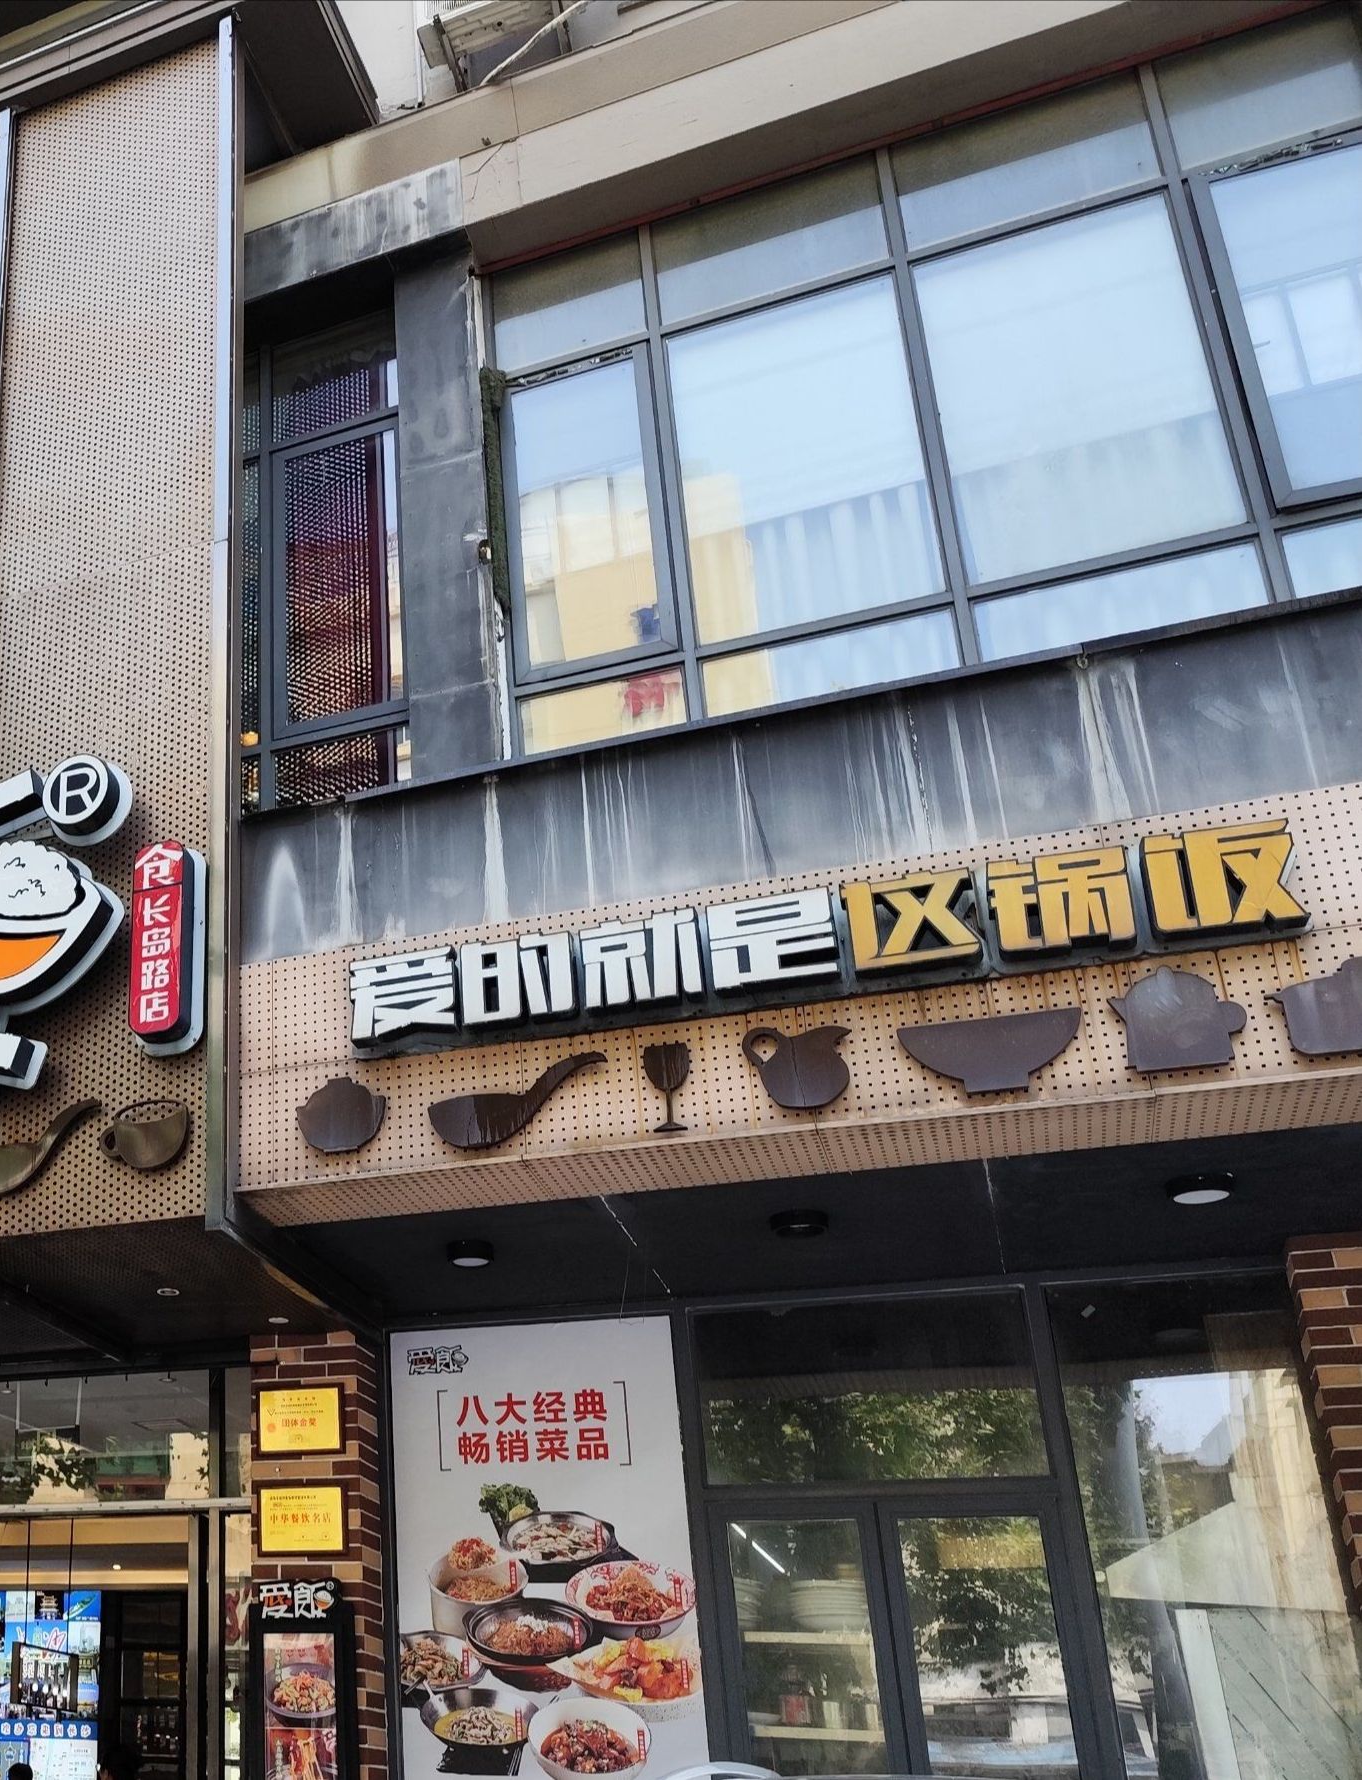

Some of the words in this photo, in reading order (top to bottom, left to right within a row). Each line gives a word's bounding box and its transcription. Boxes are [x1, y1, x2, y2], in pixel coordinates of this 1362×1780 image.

[456, 1388, 608, 1428] 八大经典
[457, 1427, 610, 1465] 畅销菜品
[269, 1512, 332, 1525] 中华餐饮名店
